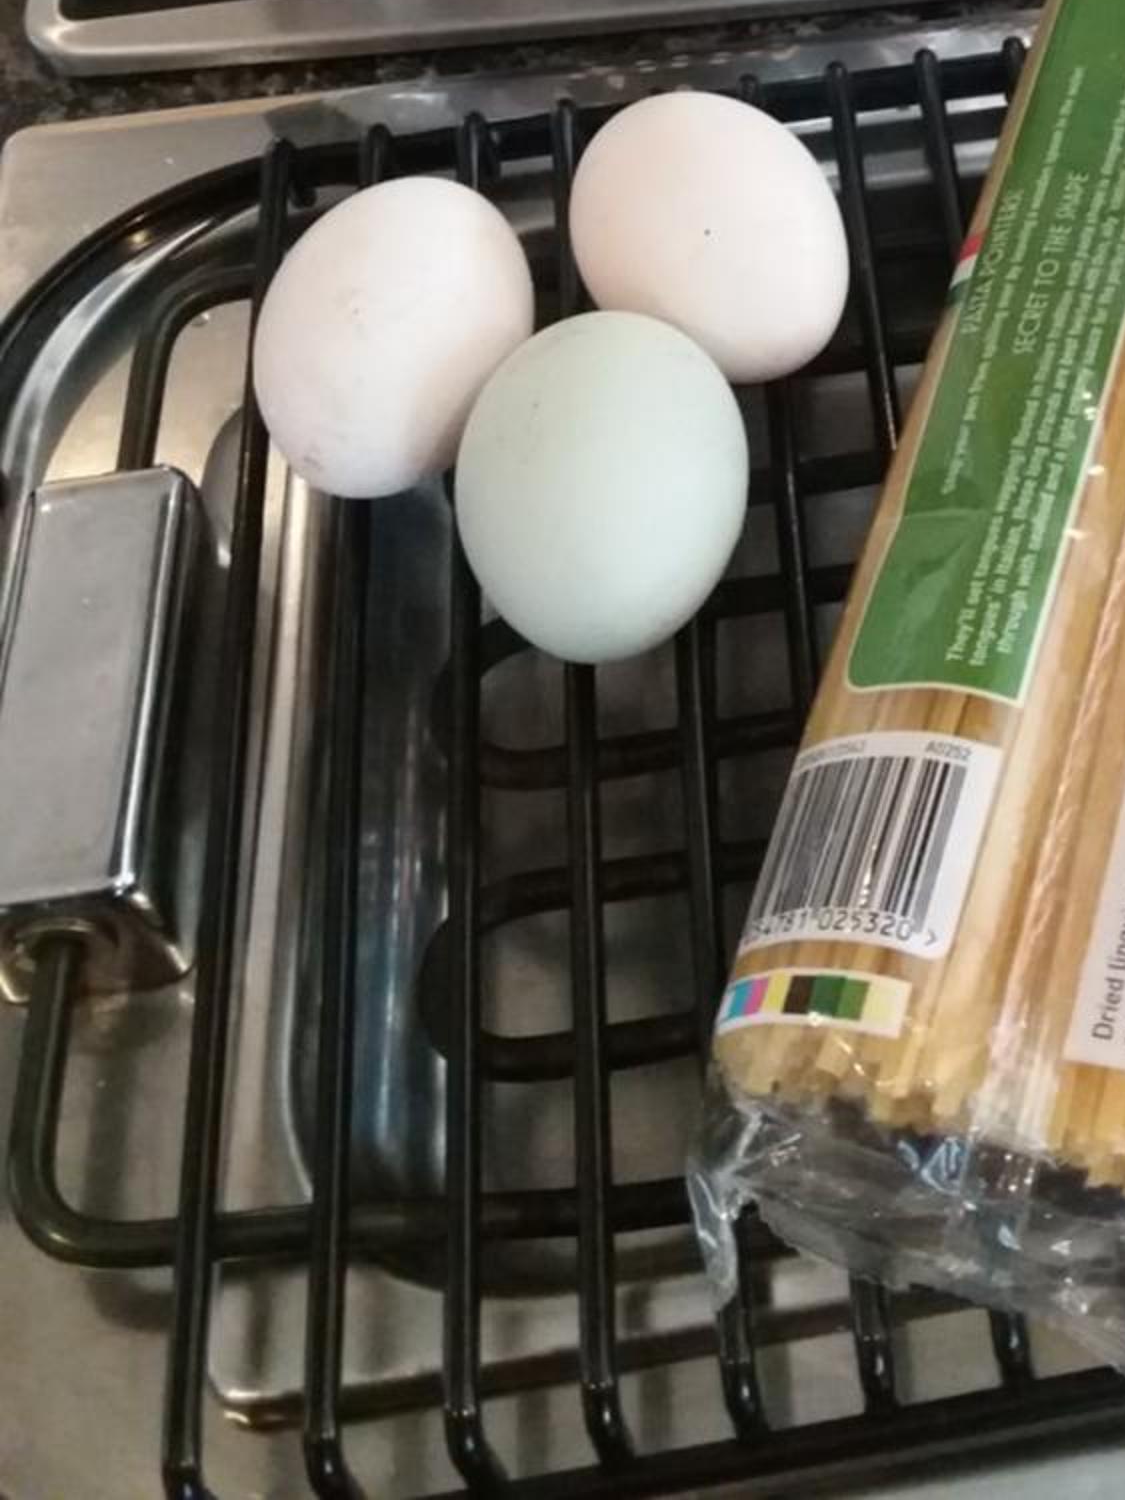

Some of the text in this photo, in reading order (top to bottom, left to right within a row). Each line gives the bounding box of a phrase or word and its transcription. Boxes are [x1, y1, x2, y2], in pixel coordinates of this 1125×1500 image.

[1010, 170, 1090, 354] SECRET TO THE SHAPE
[973, 514, 1007, 577] tongues
[964, 579, 984, 605] set
[988, 578, 1008, 593] in
[995, 590, 1031, 653] through
[1014, 553, 1038, 586] with
[944, 607, 979, 661] They'll
[818, 907, 912, 943] 025320
